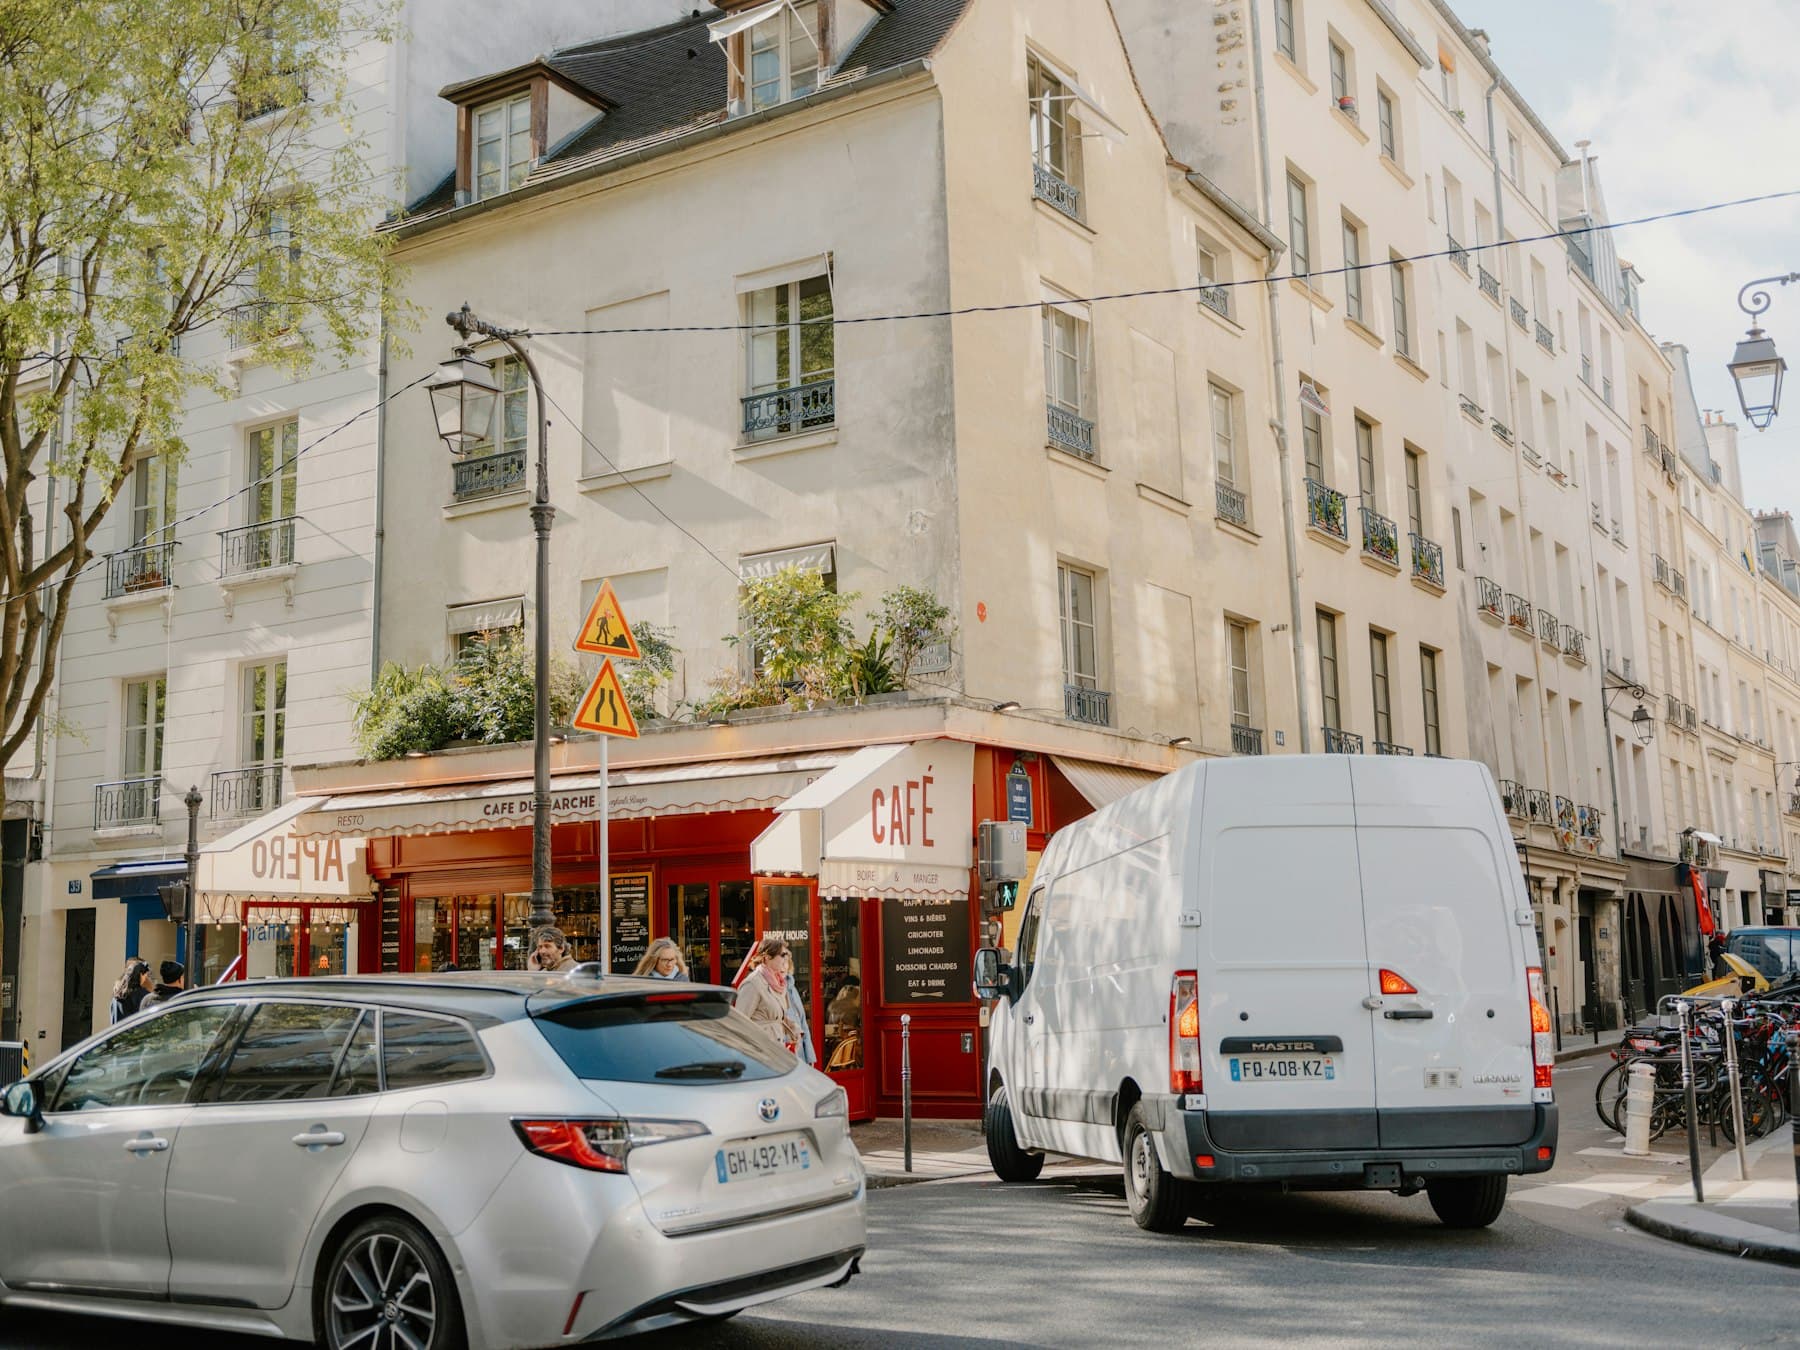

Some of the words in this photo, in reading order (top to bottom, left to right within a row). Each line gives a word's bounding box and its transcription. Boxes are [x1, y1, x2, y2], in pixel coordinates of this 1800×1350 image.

[484, 802, 514, 816] CAFE
[552, 795, 596, 811] ARCHE
[872, 765, 935, 848] CAFÉ
[337, 815, 365, 827] RESTO
[857, 870, 876, 881] BOIRE
[894, 871, 900, 882] &
[913, 873, 939, 884] MANGER
[920, 914, 925, 922] &
[763, 930, 784, 941] HAPPY
[785, 930, 808, 940] HOURS
[896, 963, 927, 971] BOISSONS
[929, 962, 957, 970] CHAUDES
[1251, 1042, 1314, 1051] MASTER
